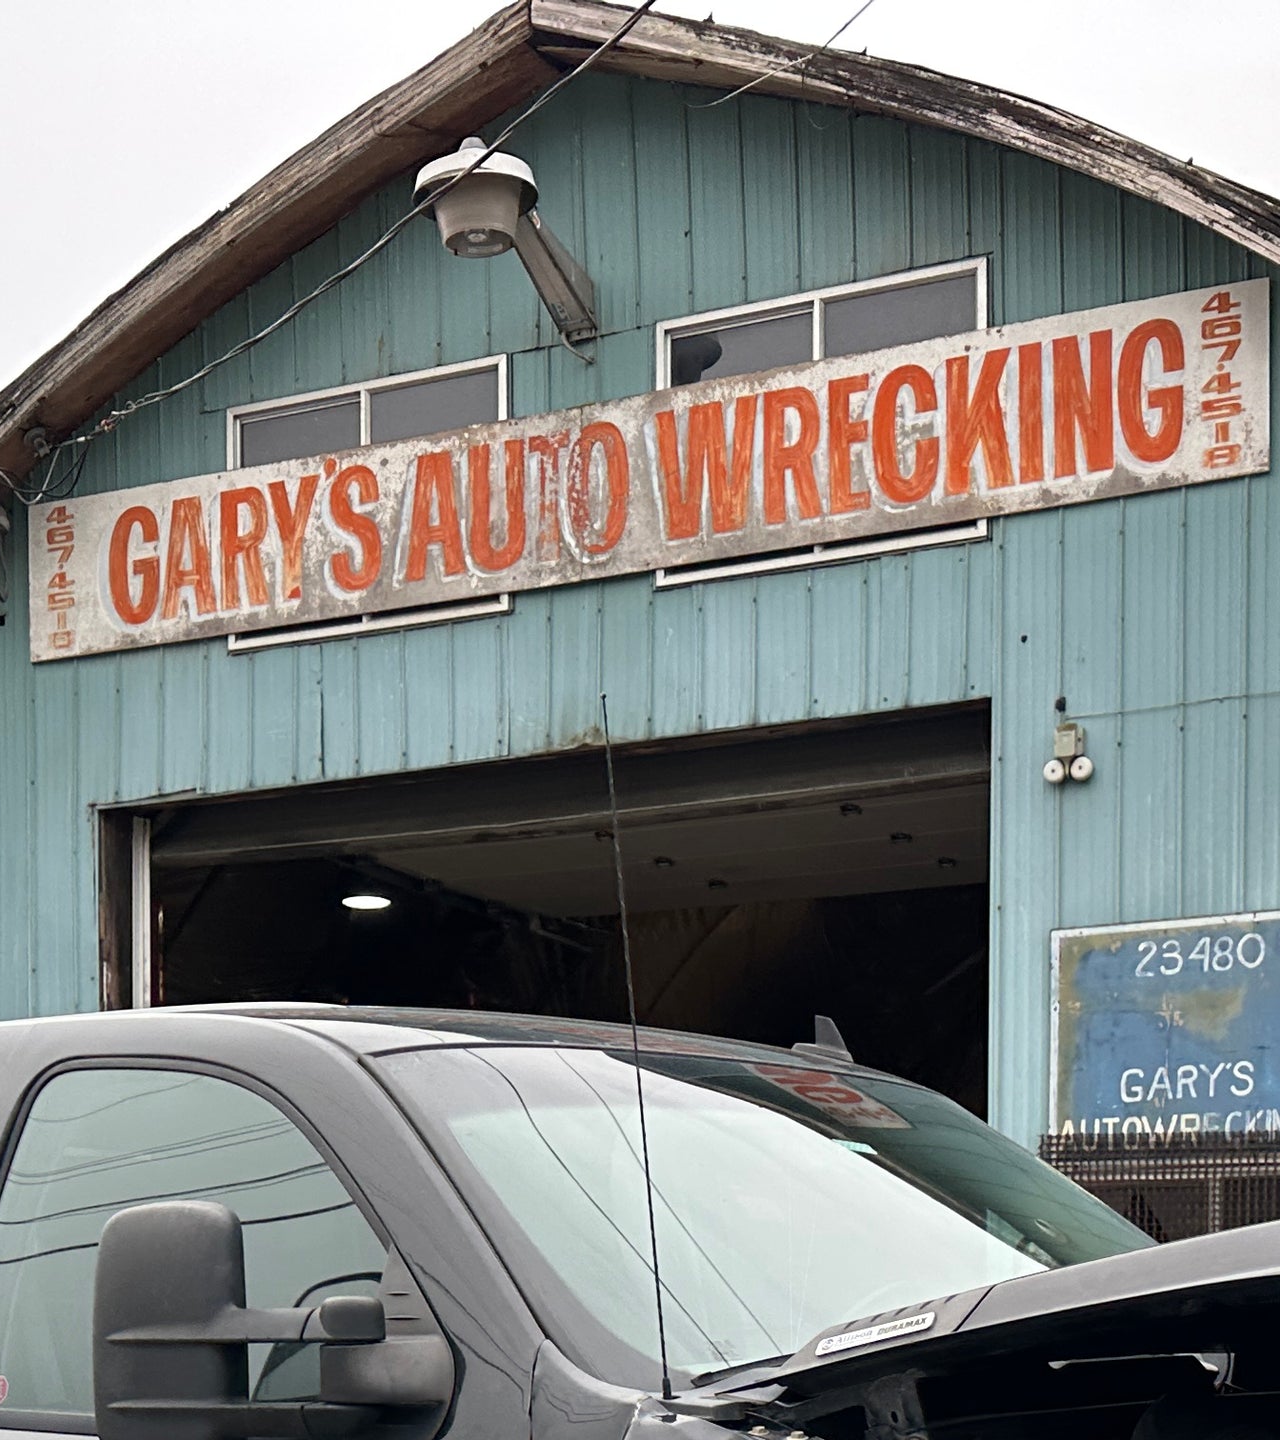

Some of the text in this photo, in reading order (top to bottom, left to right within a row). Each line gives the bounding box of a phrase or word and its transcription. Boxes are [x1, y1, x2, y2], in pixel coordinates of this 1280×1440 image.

[106, 318, 1186, 626] GARY'S AUTO WRECKING
[1134, 932, 1268, 979] 23480
[1120, 1060, 1256, 1104] GARY'S
[877, 1316, 927, 1336] DURAMAX
